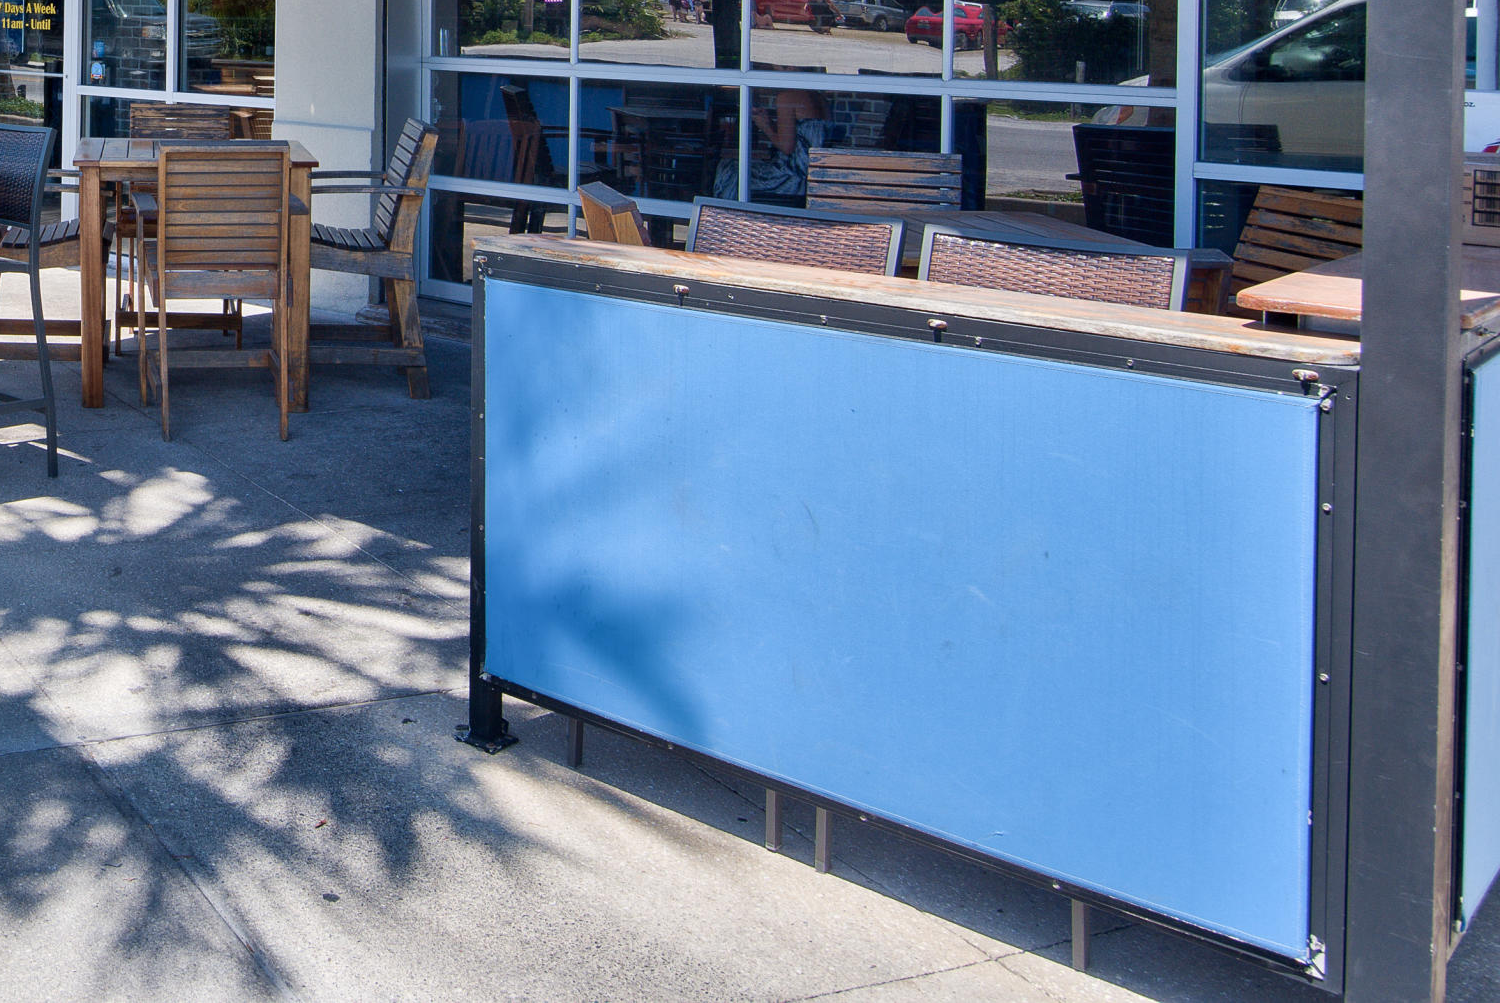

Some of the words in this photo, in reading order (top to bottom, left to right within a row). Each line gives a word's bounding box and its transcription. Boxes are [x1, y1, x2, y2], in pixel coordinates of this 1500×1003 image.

[4, 2, 24, 16] Days
[26, 2, 32, 14] A
[33, 3, 56, 14] Week
[1, 17, 24, 29] 11am
[30, 18, 51, 30] Until
